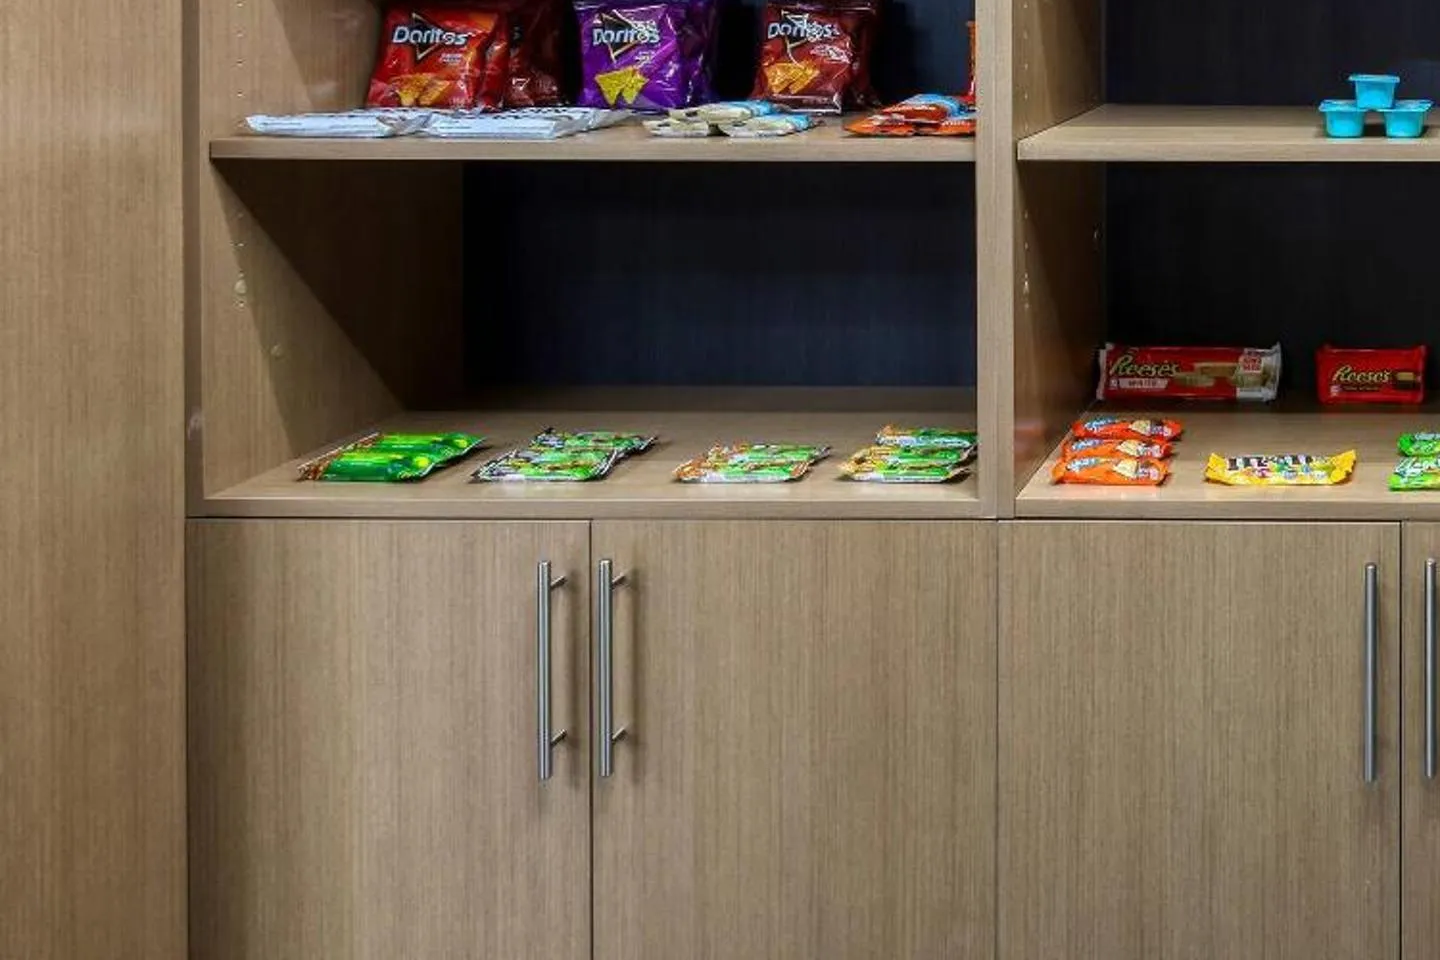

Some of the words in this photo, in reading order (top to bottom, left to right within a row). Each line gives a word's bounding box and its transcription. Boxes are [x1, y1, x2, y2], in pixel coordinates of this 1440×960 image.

[392, 25, 468, 45] Doritos
[592, 25, 661, 46] Doritos
[767, 21, 834, 40] Doritos
